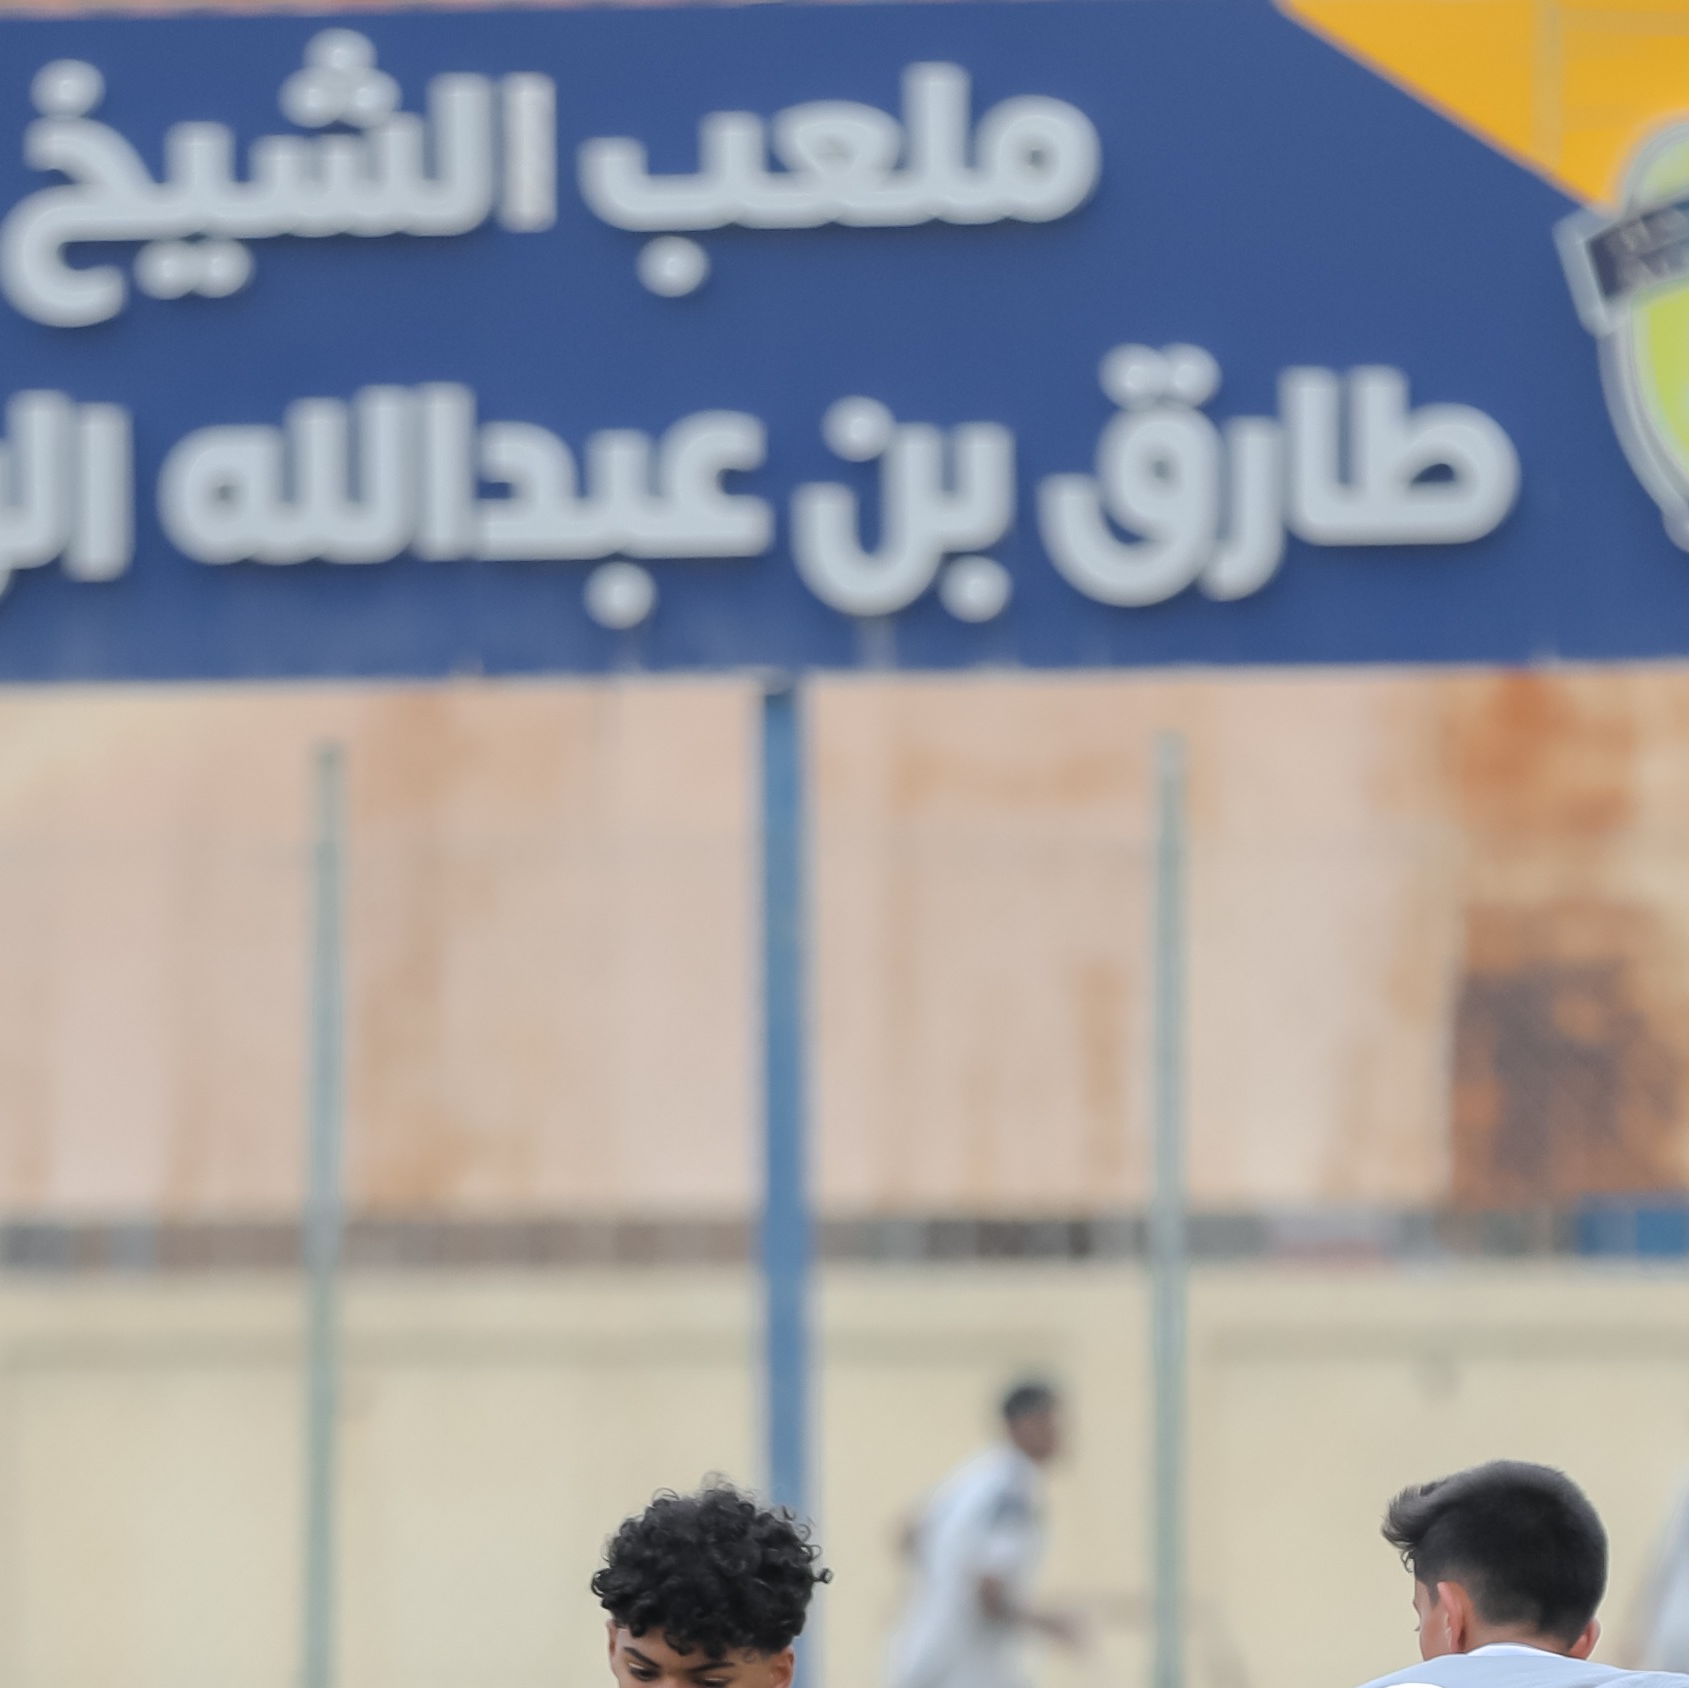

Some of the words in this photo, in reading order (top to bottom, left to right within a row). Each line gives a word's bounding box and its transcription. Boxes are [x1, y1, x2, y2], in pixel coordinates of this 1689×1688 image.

[577, 59, 1101, 298] ملعب
[159, 382, 773, 629] عبدالله
[791, 396, 1014, 622] بن
[1038, 343, 1519, 607] طارق
